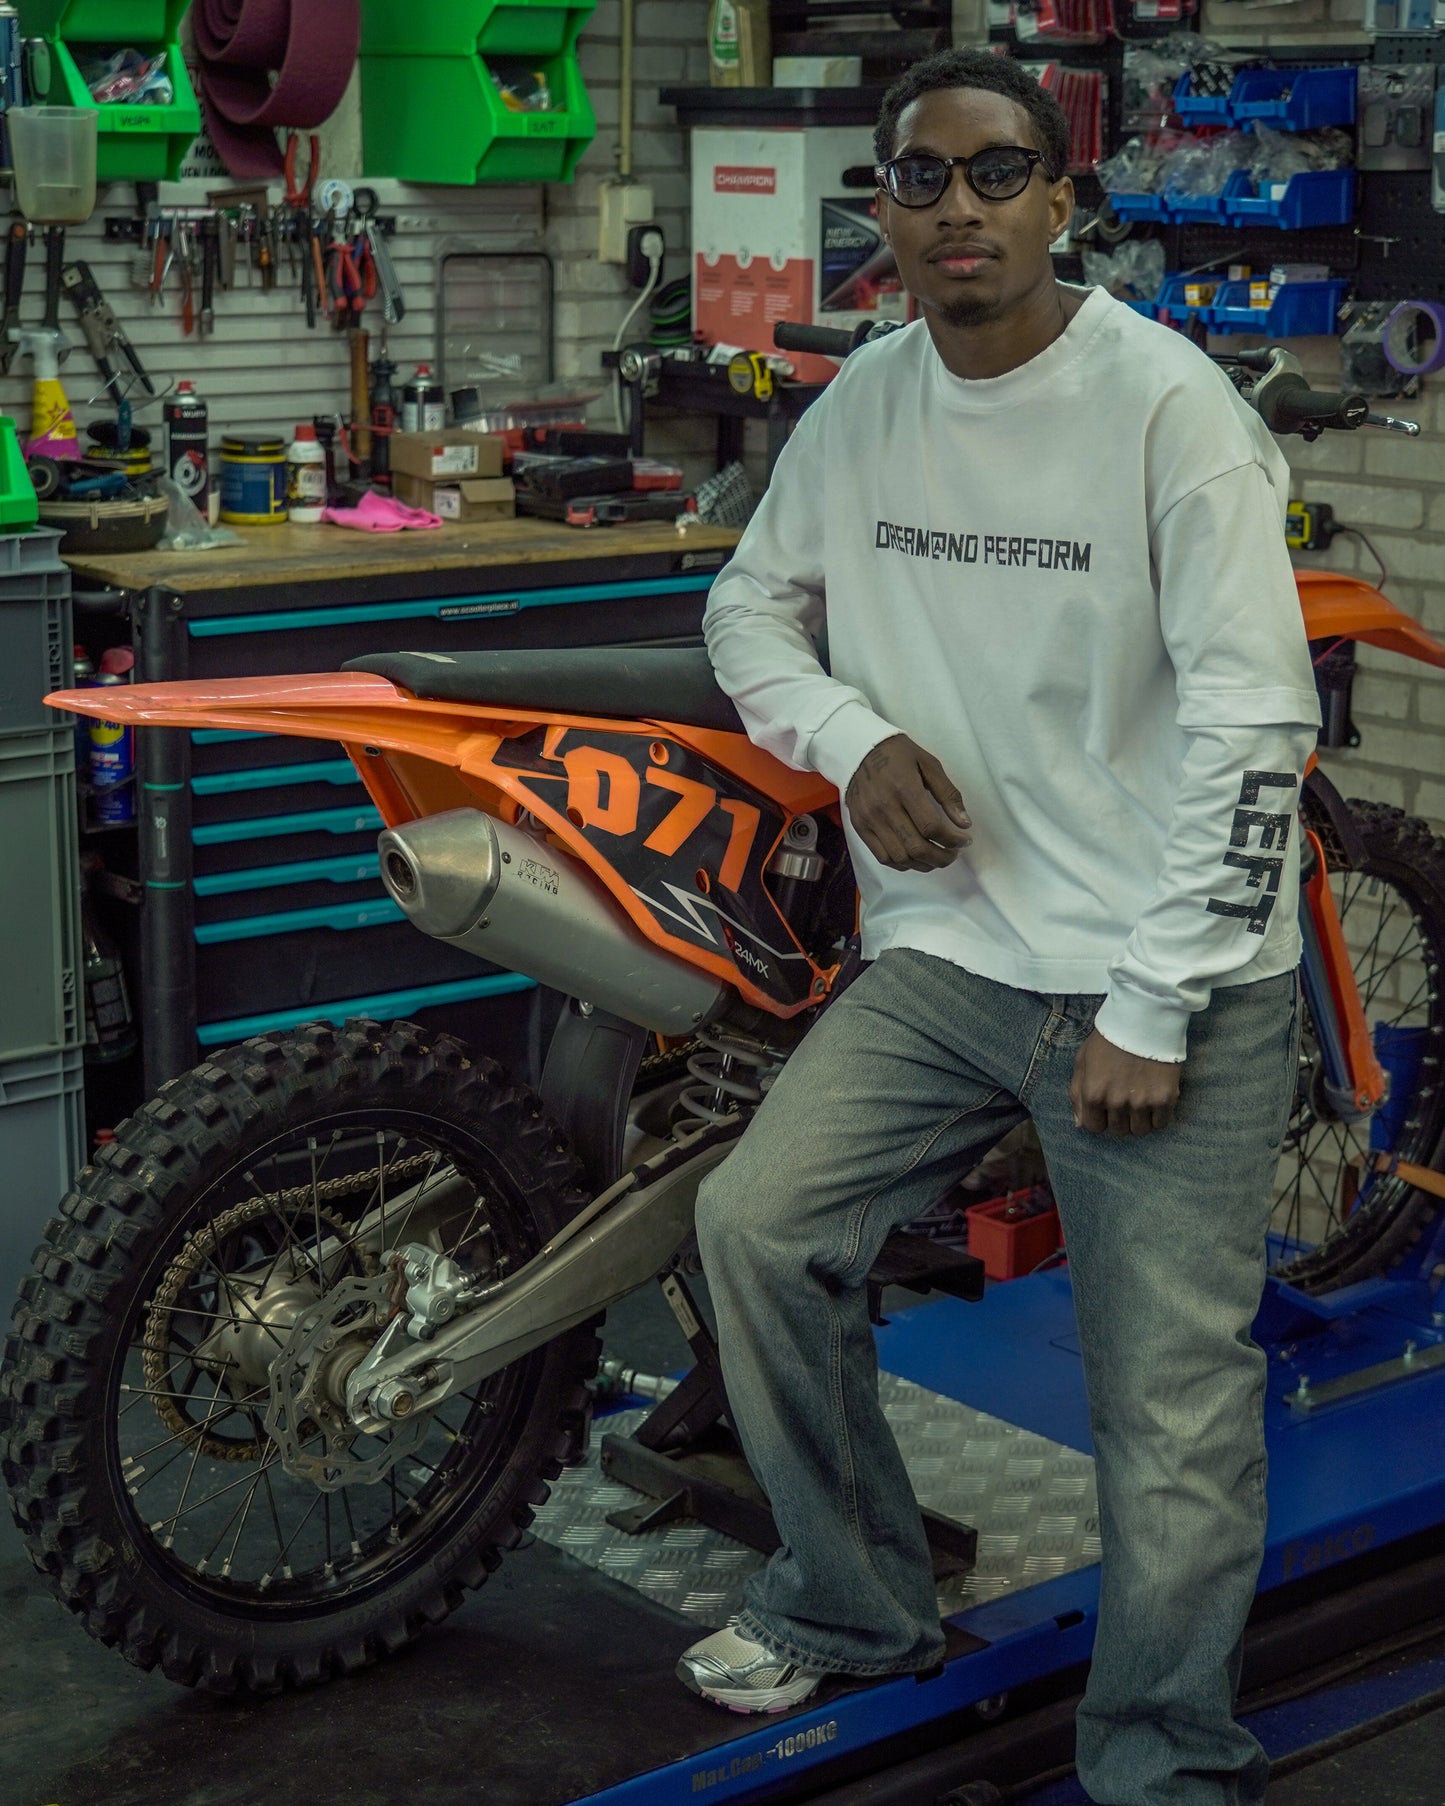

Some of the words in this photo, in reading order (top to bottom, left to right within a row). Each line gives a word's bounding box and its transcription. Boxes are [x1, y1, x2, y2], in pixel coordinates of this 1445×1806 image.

[716, 174, 775, 188] CHAMPION
[824, 237, 869, 249] ENERGY
[826, 227, 854, 238] NEW
[984, 535, 1092, 572] PERFORM
[563, 745, 761, 893] 071
[1205, 770, 1298, 936] LEFT
[517, 870, 558, 895] RACING
[520, 858, 559, 888] KTM
[734, 941, 769, 979] 24MX
[1283, 1523, 1376, 1580] Falco
